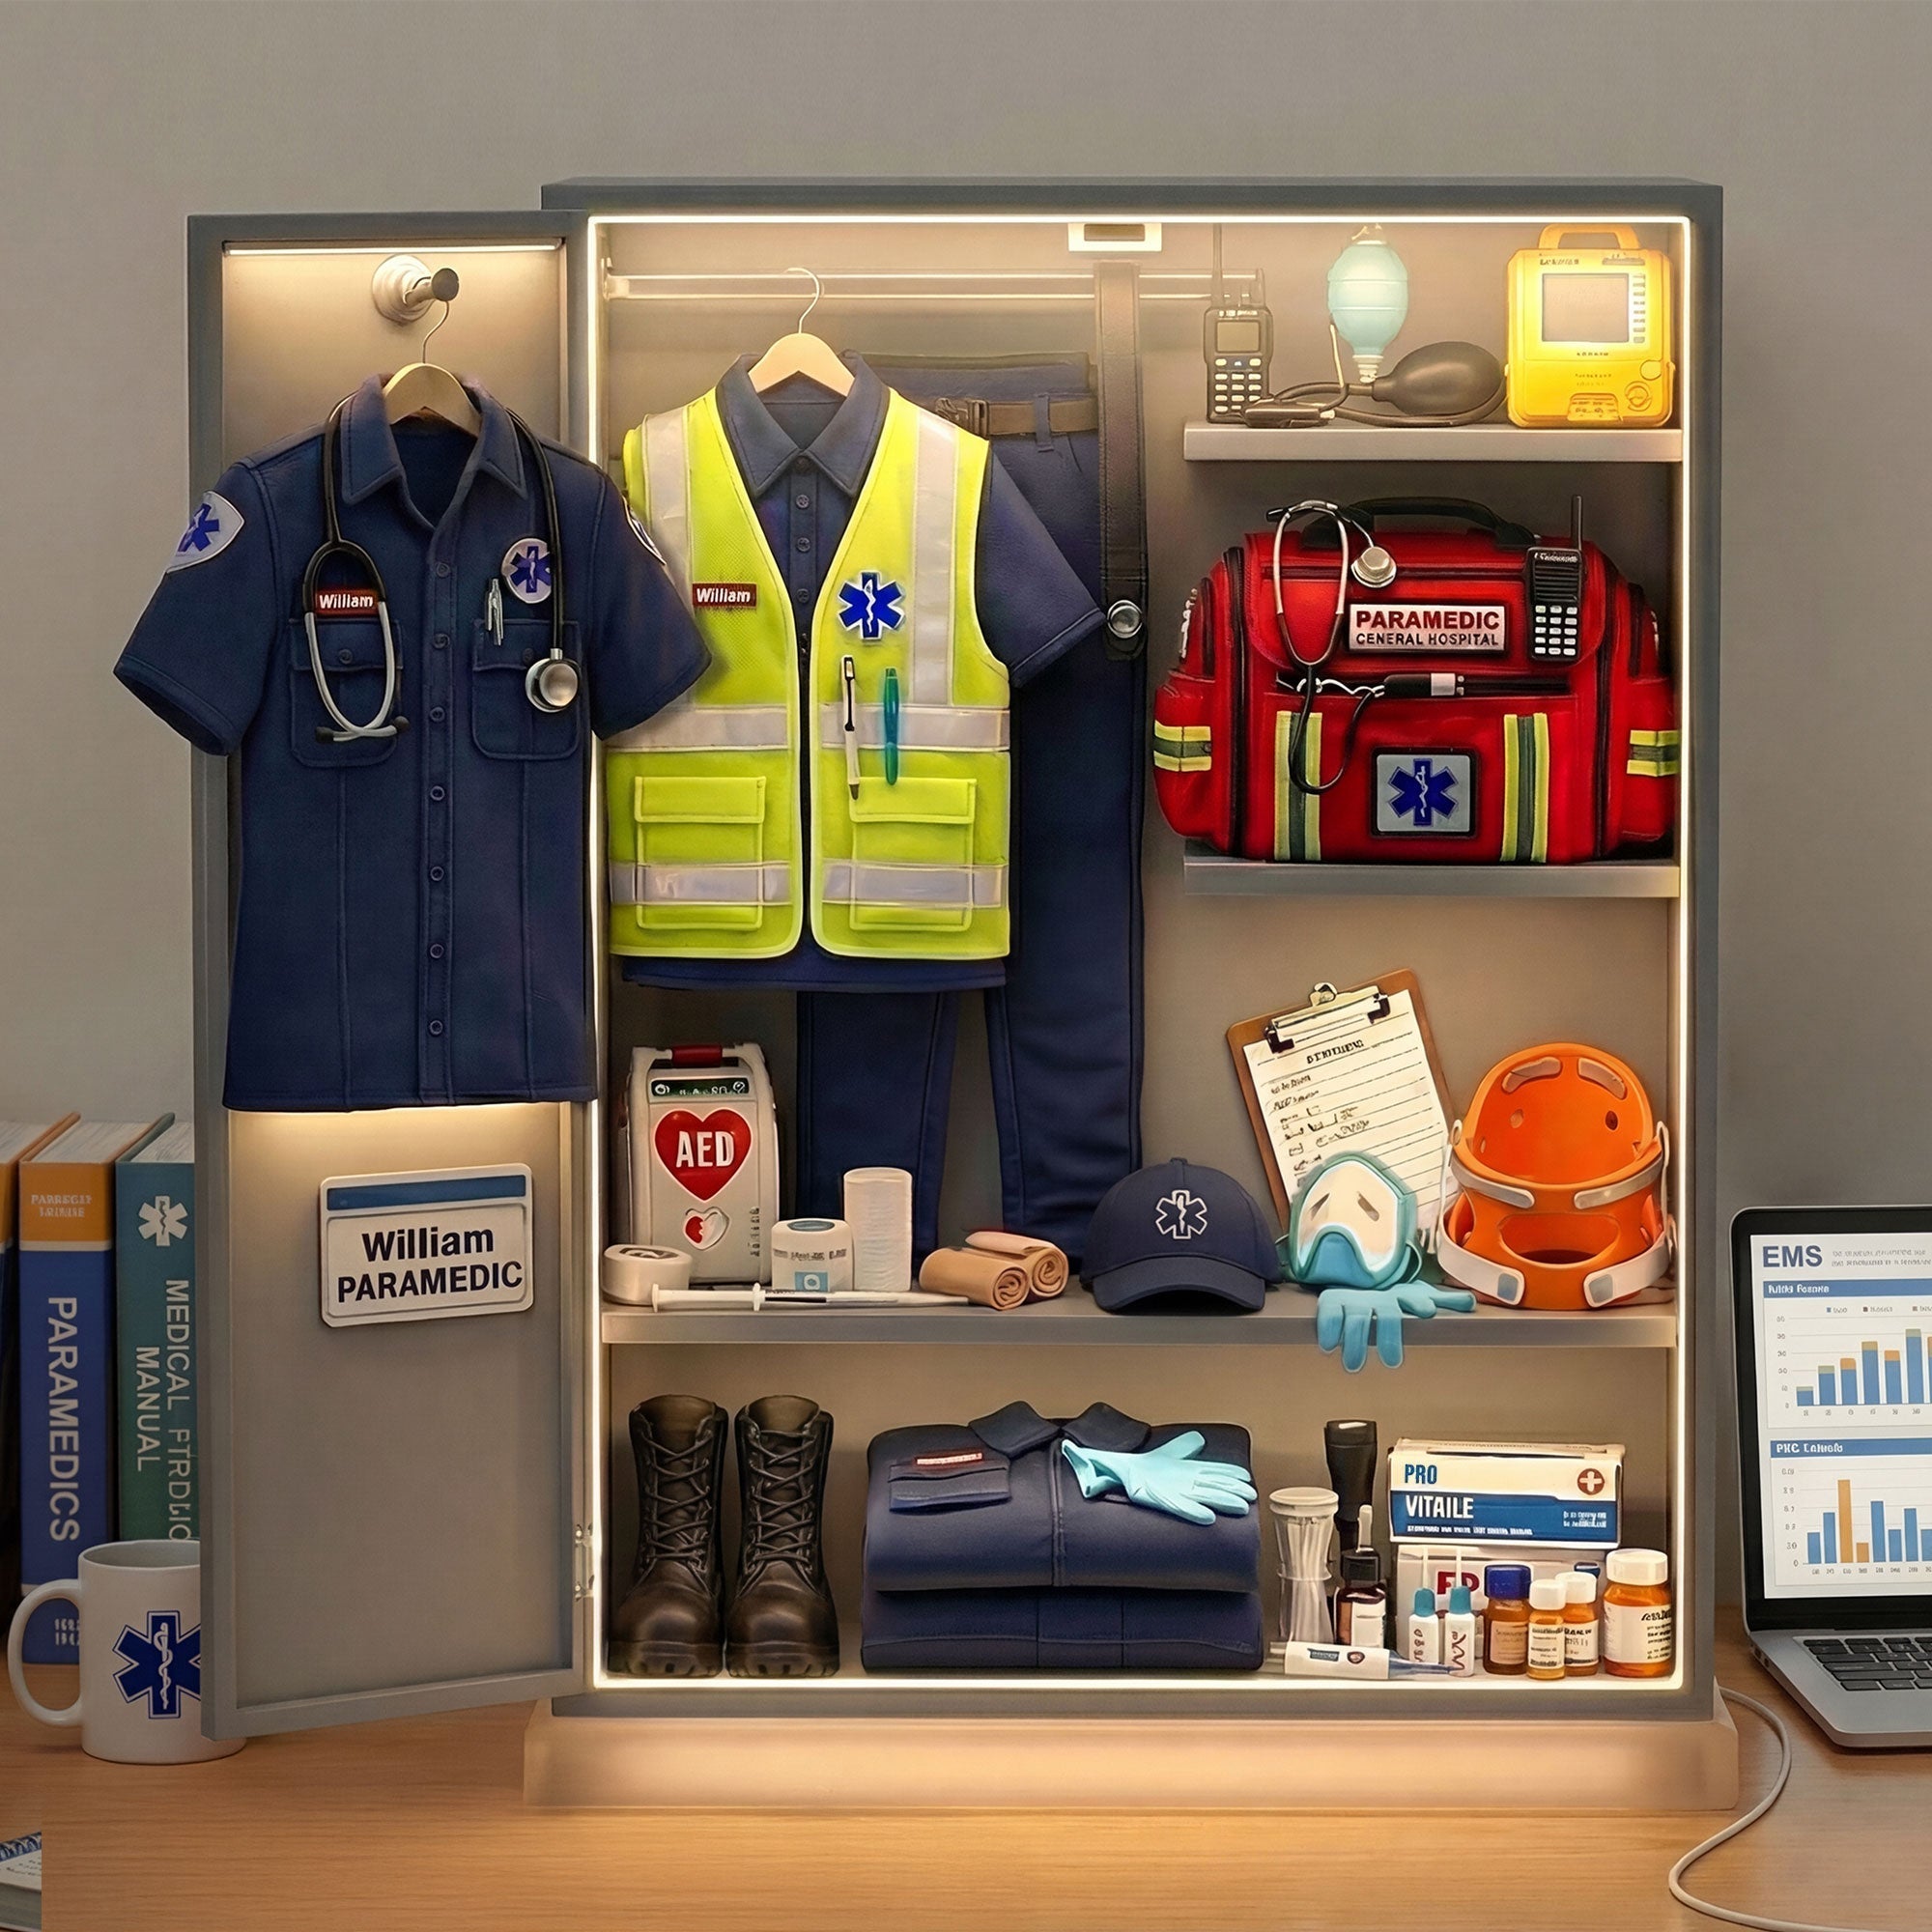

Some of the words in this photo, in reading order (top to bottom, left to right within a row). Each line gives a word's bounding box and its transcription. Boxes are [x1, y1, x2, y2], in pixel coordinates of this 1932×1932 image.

[319, 593, 374, 609] William
[696, 587, 751, 603] William
[1355, 611, 1500, 630] PARAMEDIC
[1428, 633, 1499, 646] HOSPITAL
[676, 1130, 734, 1168] AED
[361, 1226, 495, 1263] William
[1762, 1244, 1823, 1267] EMS
[338, 1260, 523, 1303] PARAMEDIC
[166, 1280, 190, 1410] MEDICAL
[48, 1297, 80, 1541] PARAMEDICS
[136, 1347, 160, 1472] MANUAL
[1405, 1463, 1437, 1485] PRO
[1406, 1494, 1474, 1519] VITAILE
